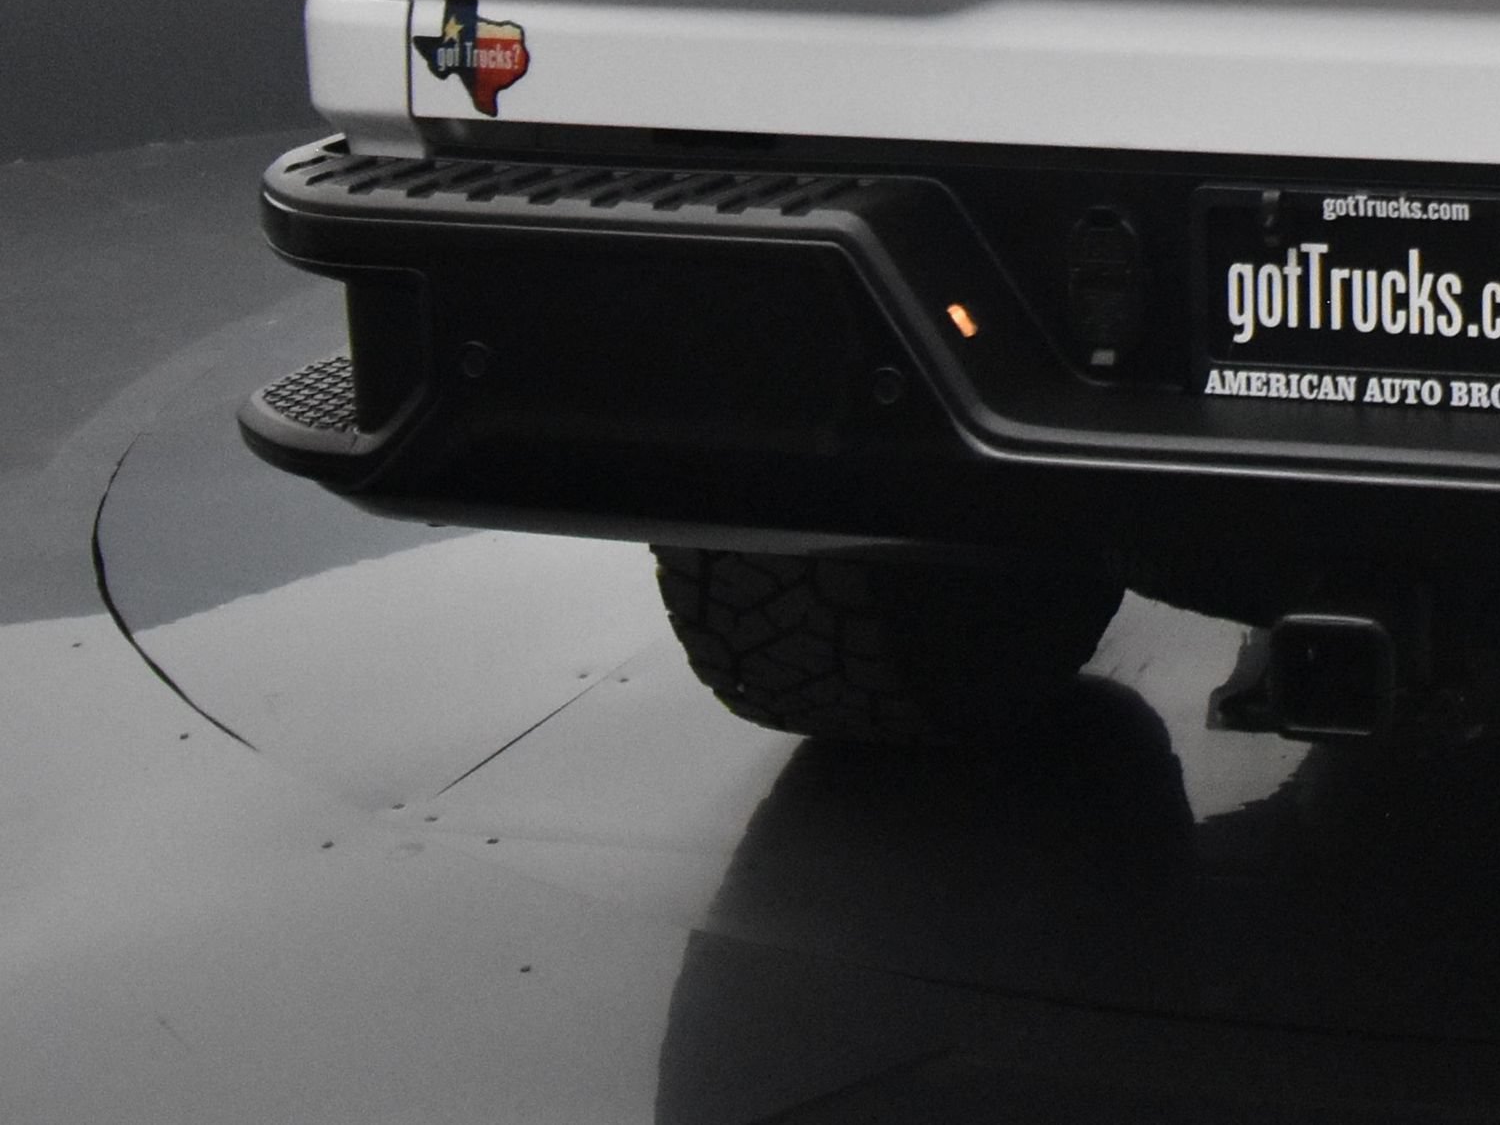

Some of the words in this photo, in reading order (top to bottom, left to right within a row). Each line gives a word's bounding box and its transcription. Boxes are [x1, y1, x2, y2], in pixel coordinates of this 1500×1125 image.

[437, 45, 460, 71] got
[464, 41, 521, 70] Trucks?
[1322, 194, 1470, 222] gotTrucks.com
[1204, 369, 1357, 401] AMERICAN
[1363, 377, 1443, 406] AUTO
